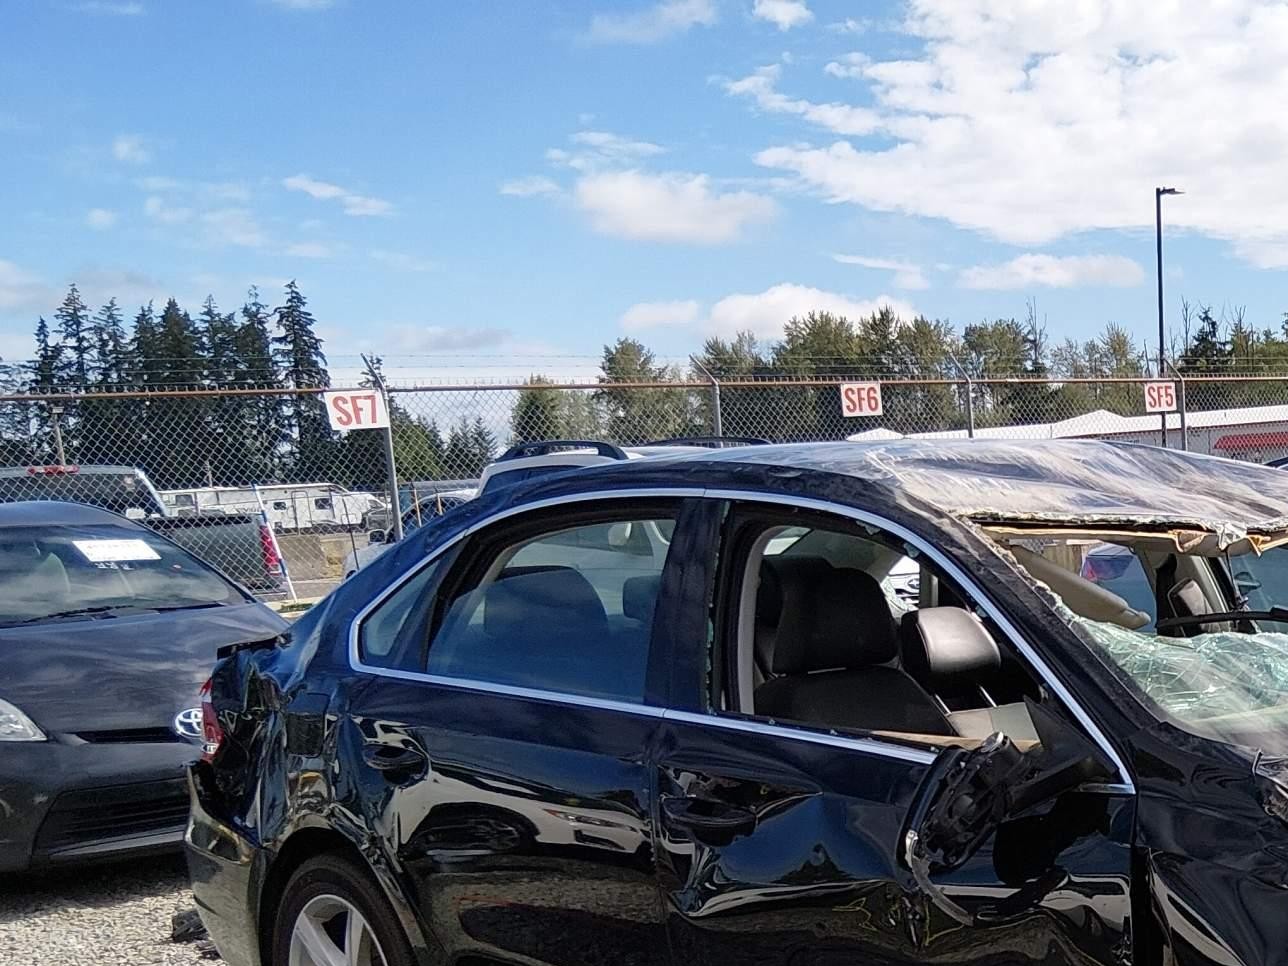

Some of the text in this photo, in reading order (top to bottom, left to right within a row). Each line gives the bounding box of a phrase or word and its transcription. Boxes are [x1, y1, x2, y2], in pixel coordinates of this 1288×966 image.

[332, 394, 378, 426] SF7
[844, 386, 879, 413] SF6
[1147, 385, 1174, 408] SF5
